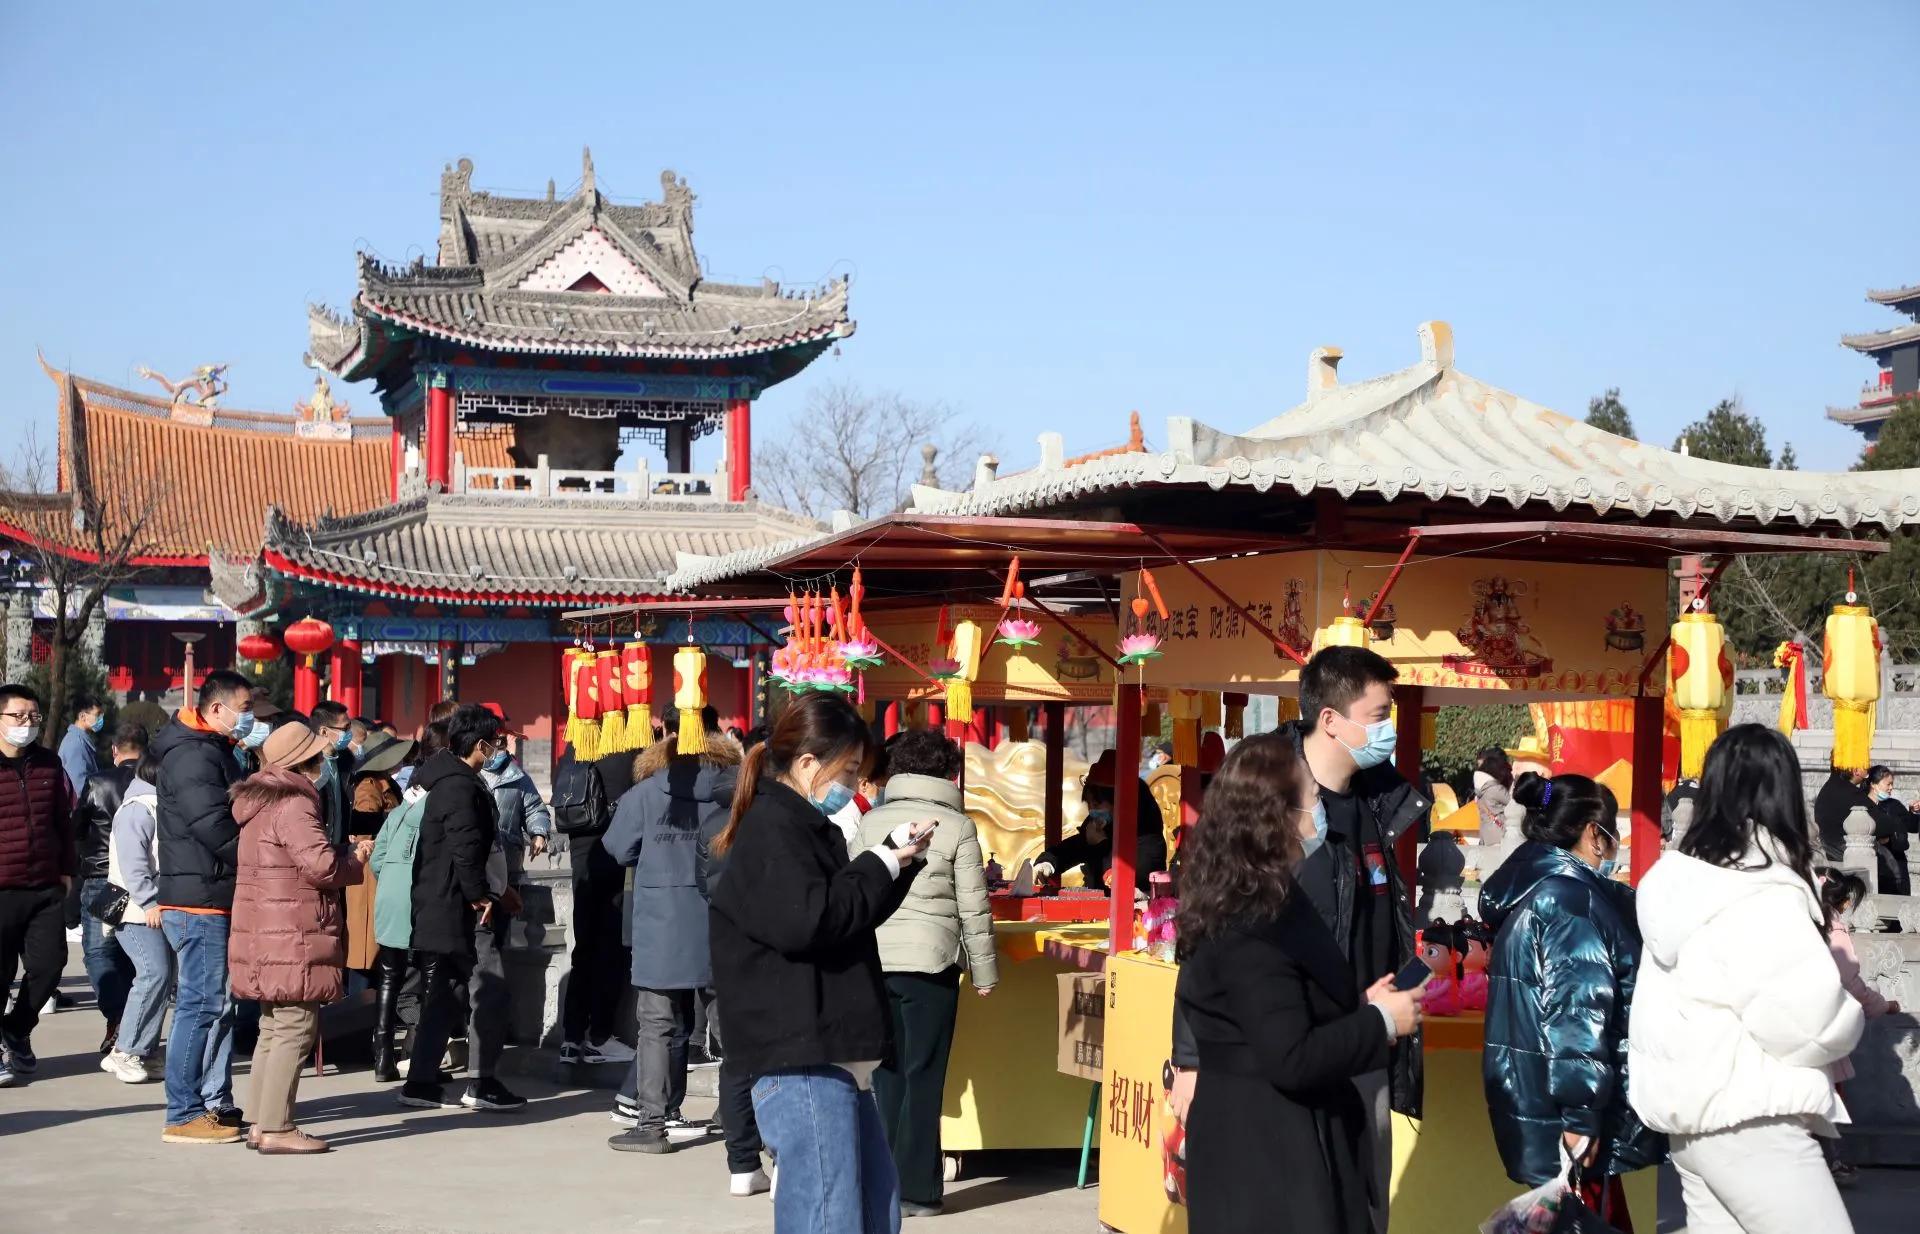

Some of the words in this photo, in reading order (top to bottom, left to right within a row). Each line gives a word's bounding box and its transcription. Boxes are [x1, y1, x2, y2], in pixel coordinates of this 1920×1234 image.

[1209, 601, 1273, 639] 财源广进
[1109, 1069, 1155, 1149] 招财
